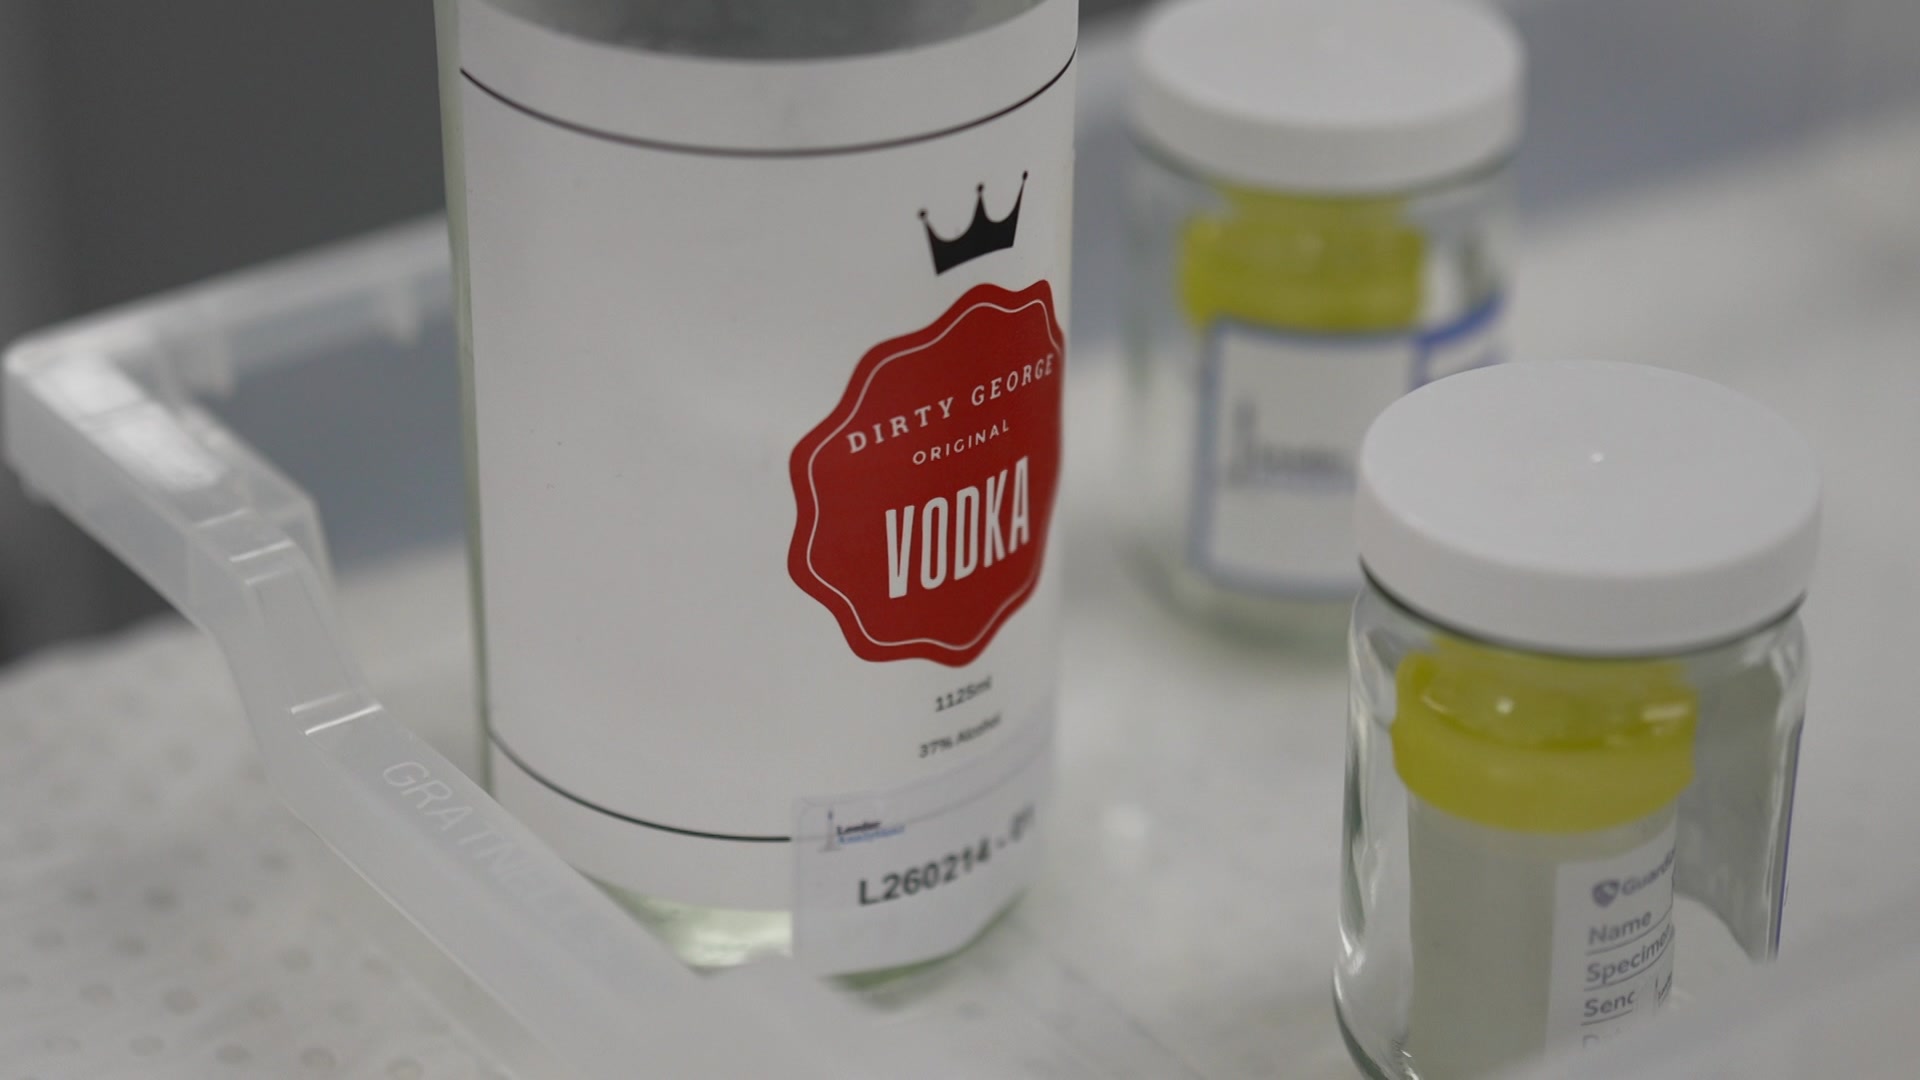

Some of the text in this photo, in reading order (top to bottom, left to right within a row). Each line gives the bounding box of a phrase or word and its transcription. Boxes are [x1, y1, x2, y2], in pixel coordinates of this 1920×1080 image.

[846, 352, 1055, 455] DIRTY GEORGE
[911, 418, 1011, 466] ORIGINAL
[884, 455, 1030, 600] VODKA
[1587, 910, 1653, 946] Name
